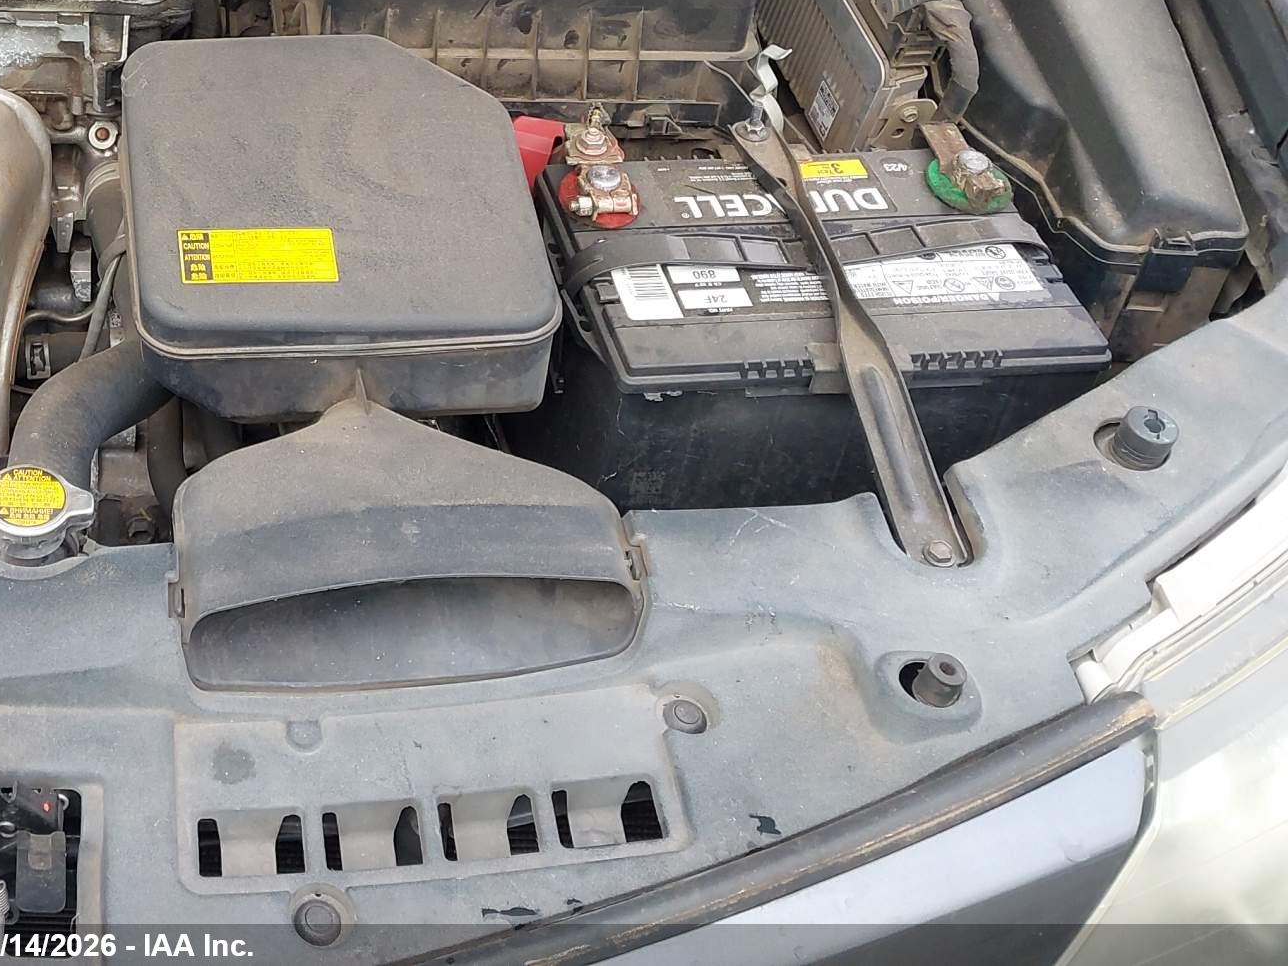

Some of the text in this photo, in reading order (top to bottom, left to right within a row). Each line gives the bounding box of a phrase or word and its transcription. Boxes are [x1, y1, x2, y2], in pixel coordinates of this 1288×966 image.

[830, 163, 843, 174] 3
[674, 187, 889, 219] DUCELL
[183, 243, 209, 251] CAUTION
[692, 269, 717, 280] 890
[703, 294, 728, 304] 24F
[13, 469, 43, 477] CAUTION
